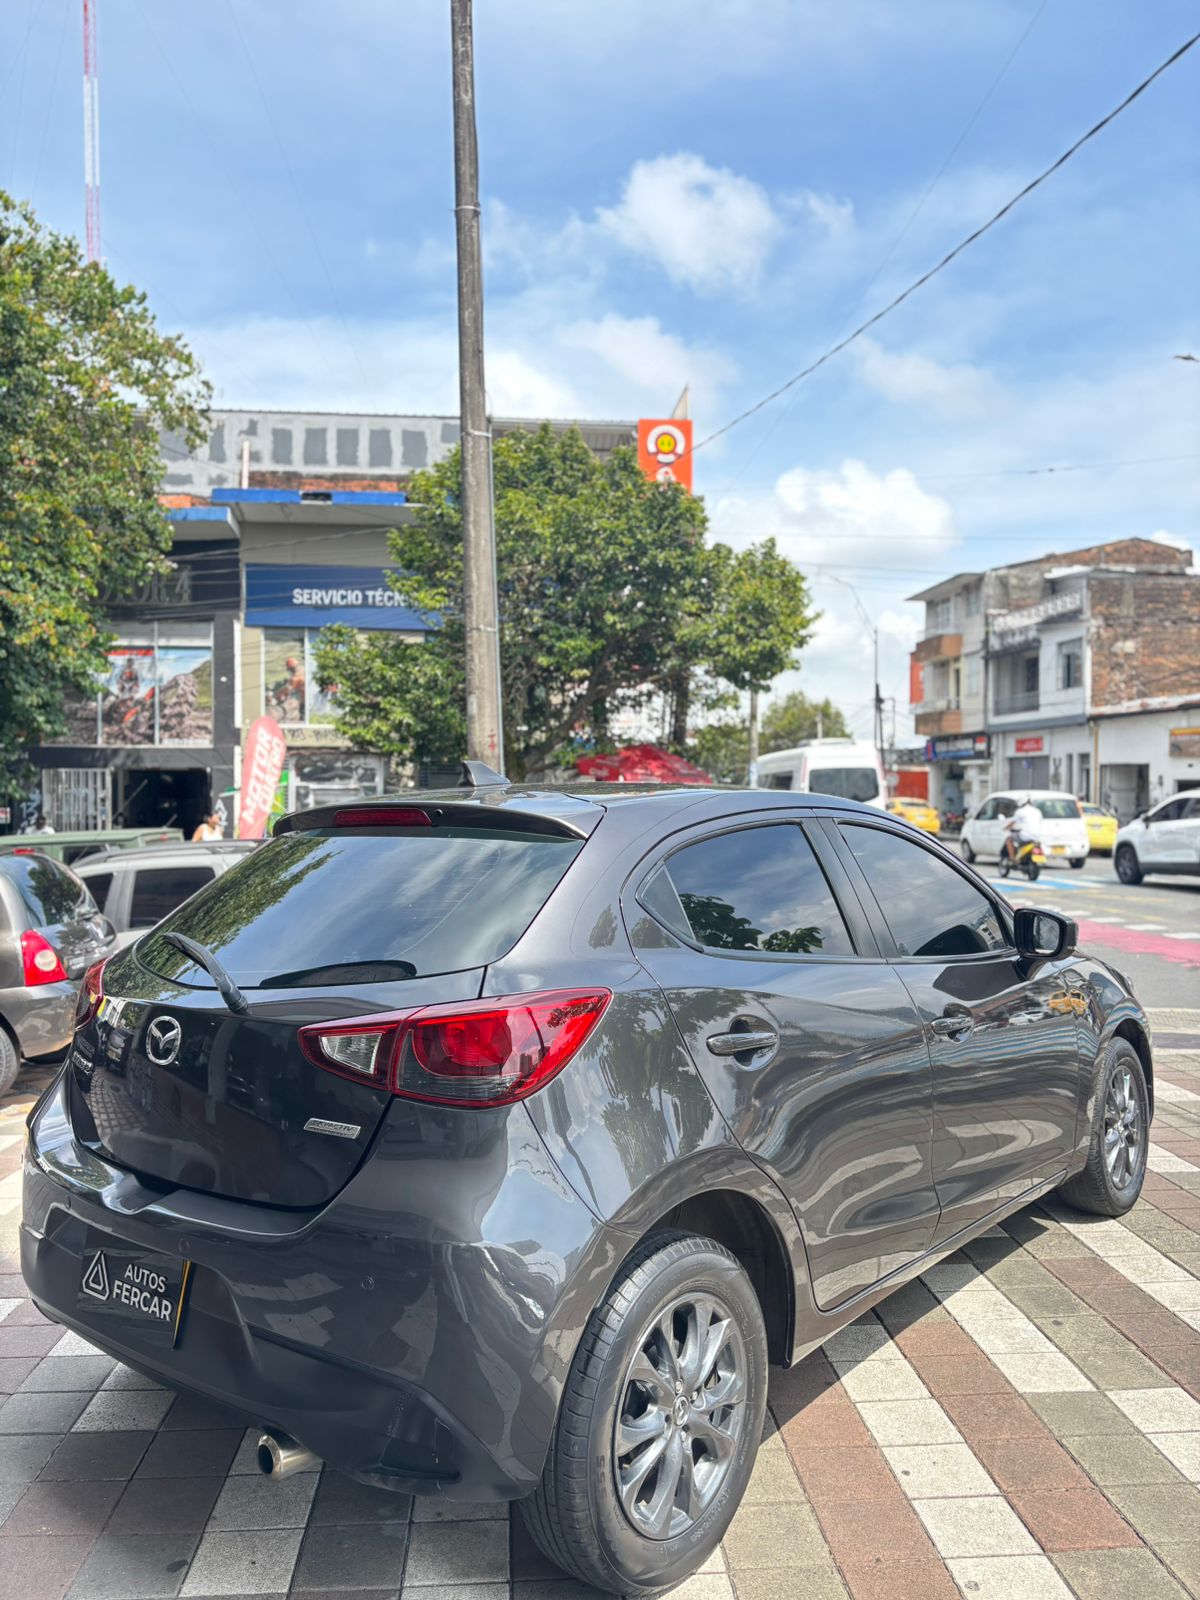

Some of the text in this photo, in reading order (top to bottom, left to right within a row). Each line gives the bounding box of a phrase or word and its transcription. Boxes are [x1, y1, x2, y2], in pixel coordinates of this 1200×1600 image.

[293, 587, 415, 607] SERVICIO TÉCN
[242, 727, 272, 824] MOTOR
[124, 1263, 166, 1293] AUTOS
[112, 1279, 172, 1322] FERCAR
